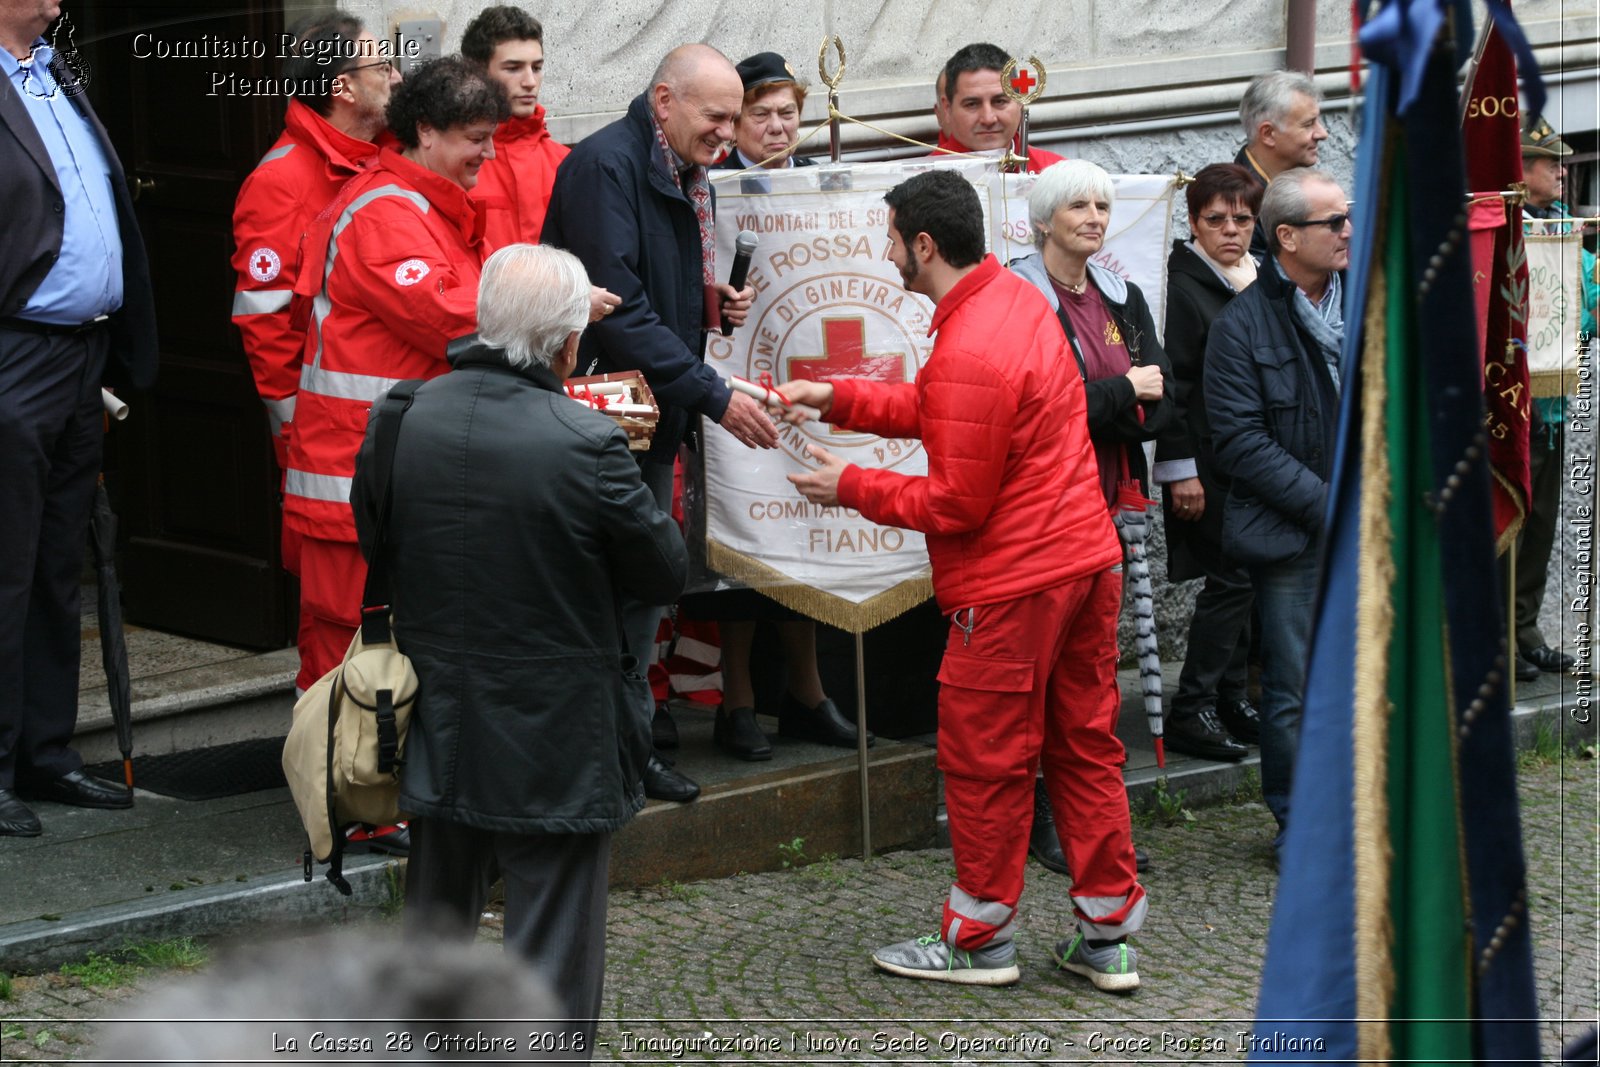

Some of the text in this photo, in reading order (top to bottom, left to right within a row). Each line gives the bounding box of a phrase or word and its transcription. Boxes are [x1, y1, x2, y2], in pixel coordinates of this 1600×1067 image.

[735, 208, 891, 234] VOLONTARI DEL SO
[768, 234, 873, 278] ROSSA
[776, 298, 802, 323] DI
[804, 279, 906, 315] GINEVRA
[808, 527, 905, 553] FIANO
